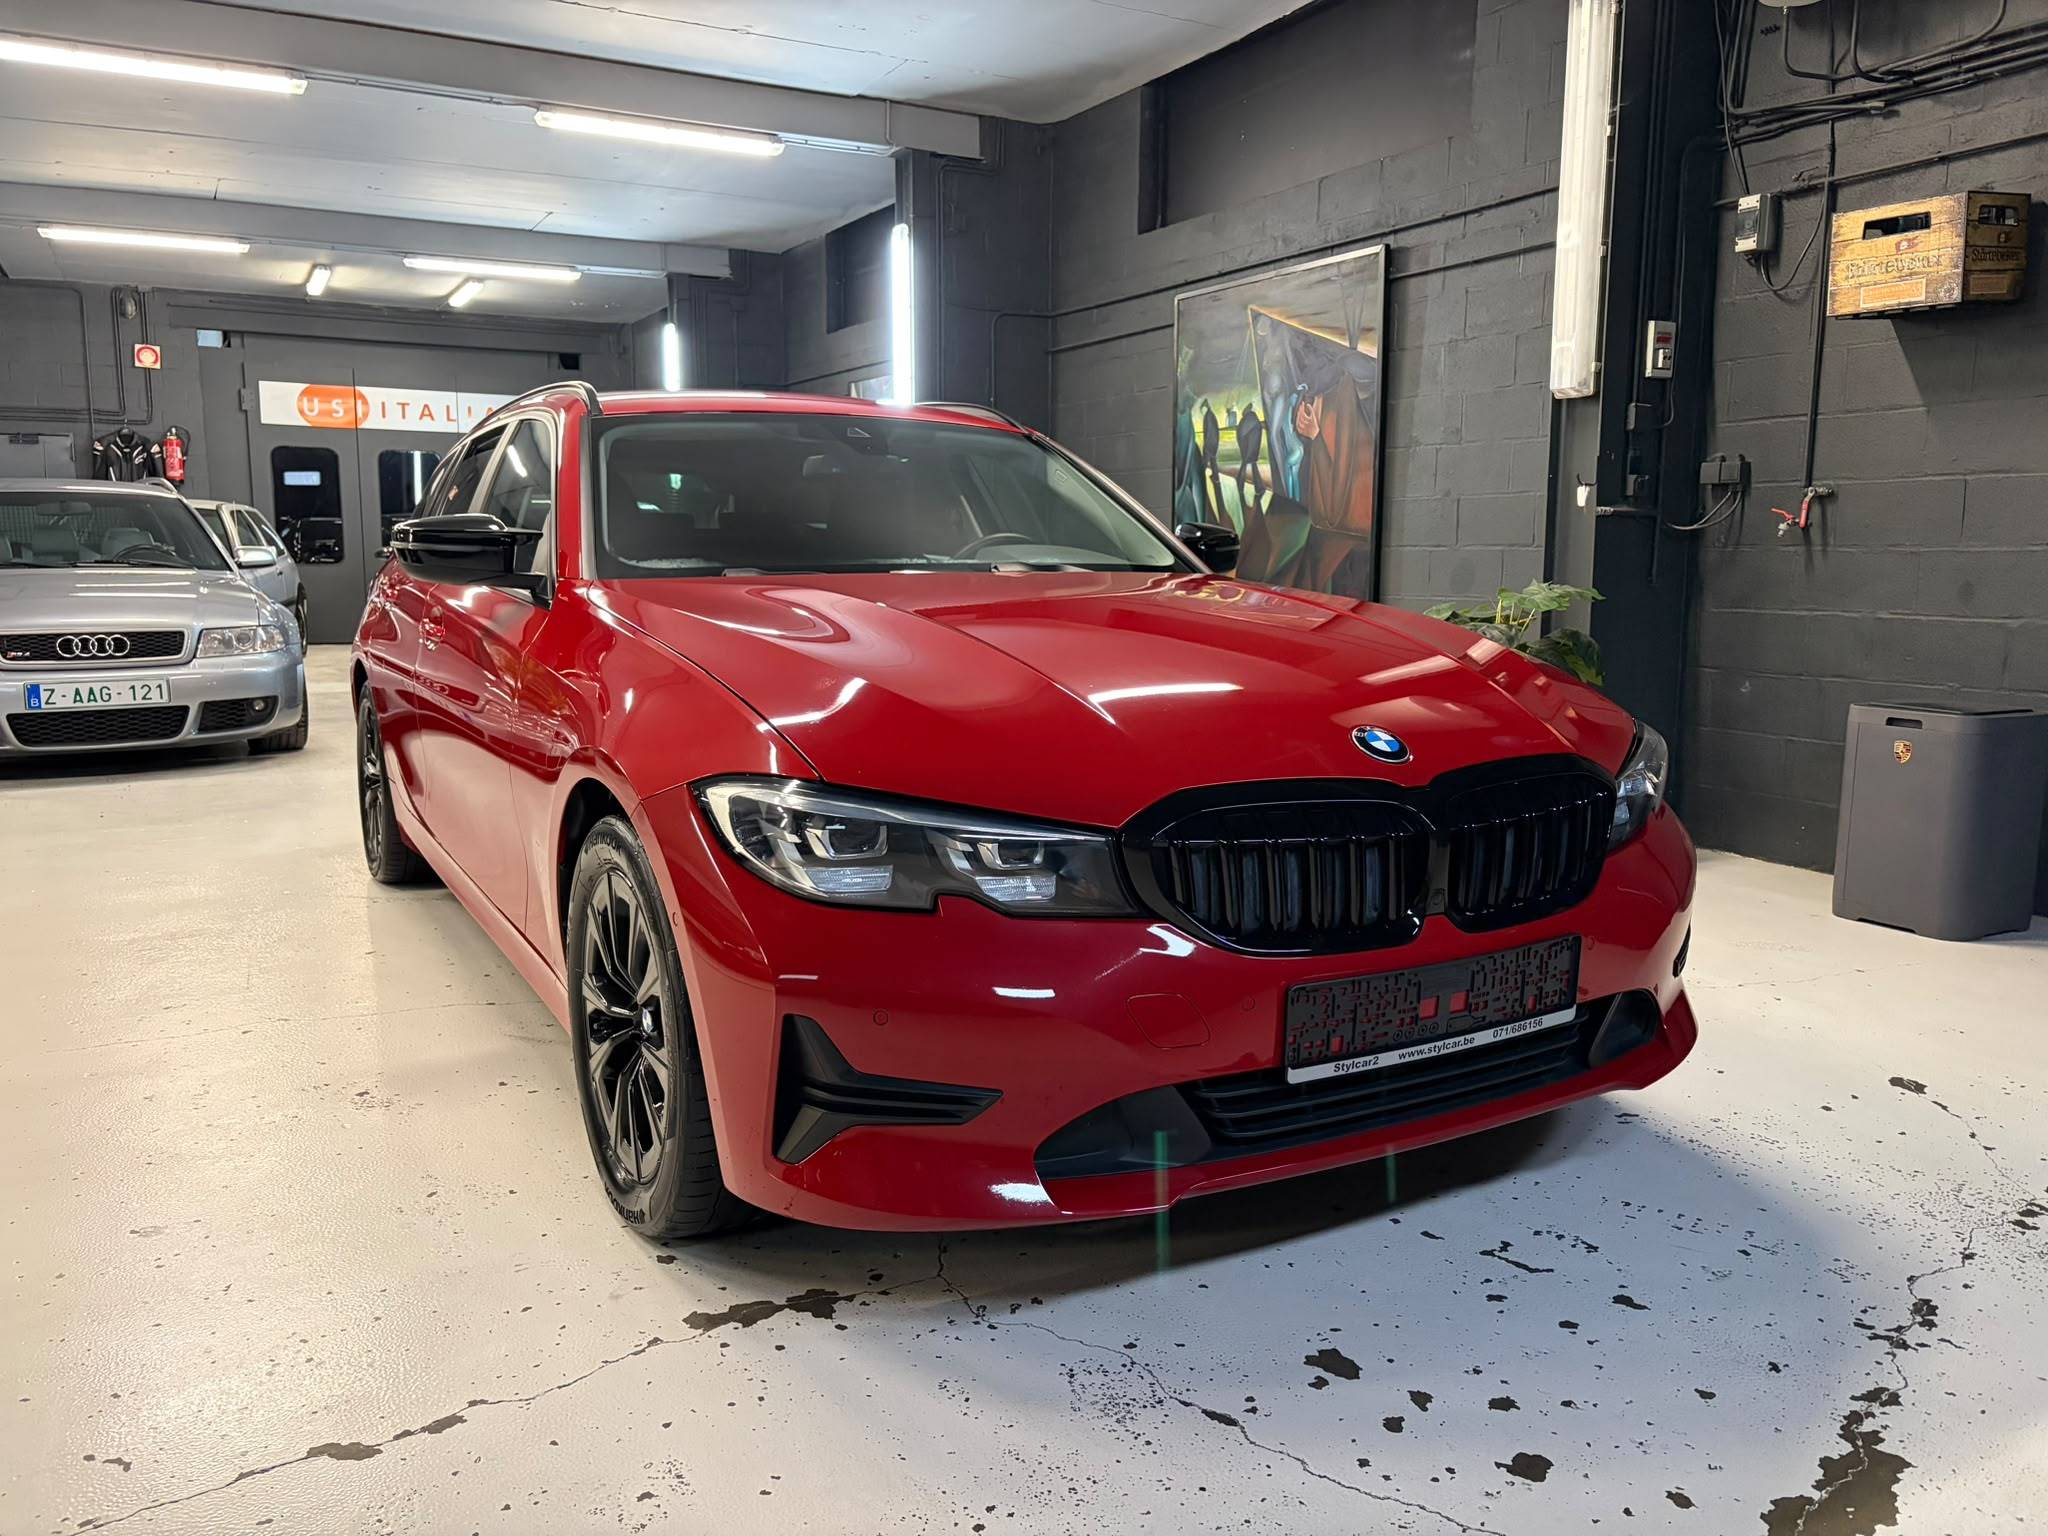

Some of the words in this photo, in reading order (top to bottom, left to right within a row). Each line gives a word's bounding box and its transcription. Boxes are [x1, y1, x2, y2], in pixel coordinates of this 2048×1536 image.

[31, 698, 40, 707] B
[1333, 1055, 1379, 1073] Stylcar2
[1398, 1035, 1475, 1060] www.stylcar.be
[1493, 1017, 1543, 1039] 071/686156
